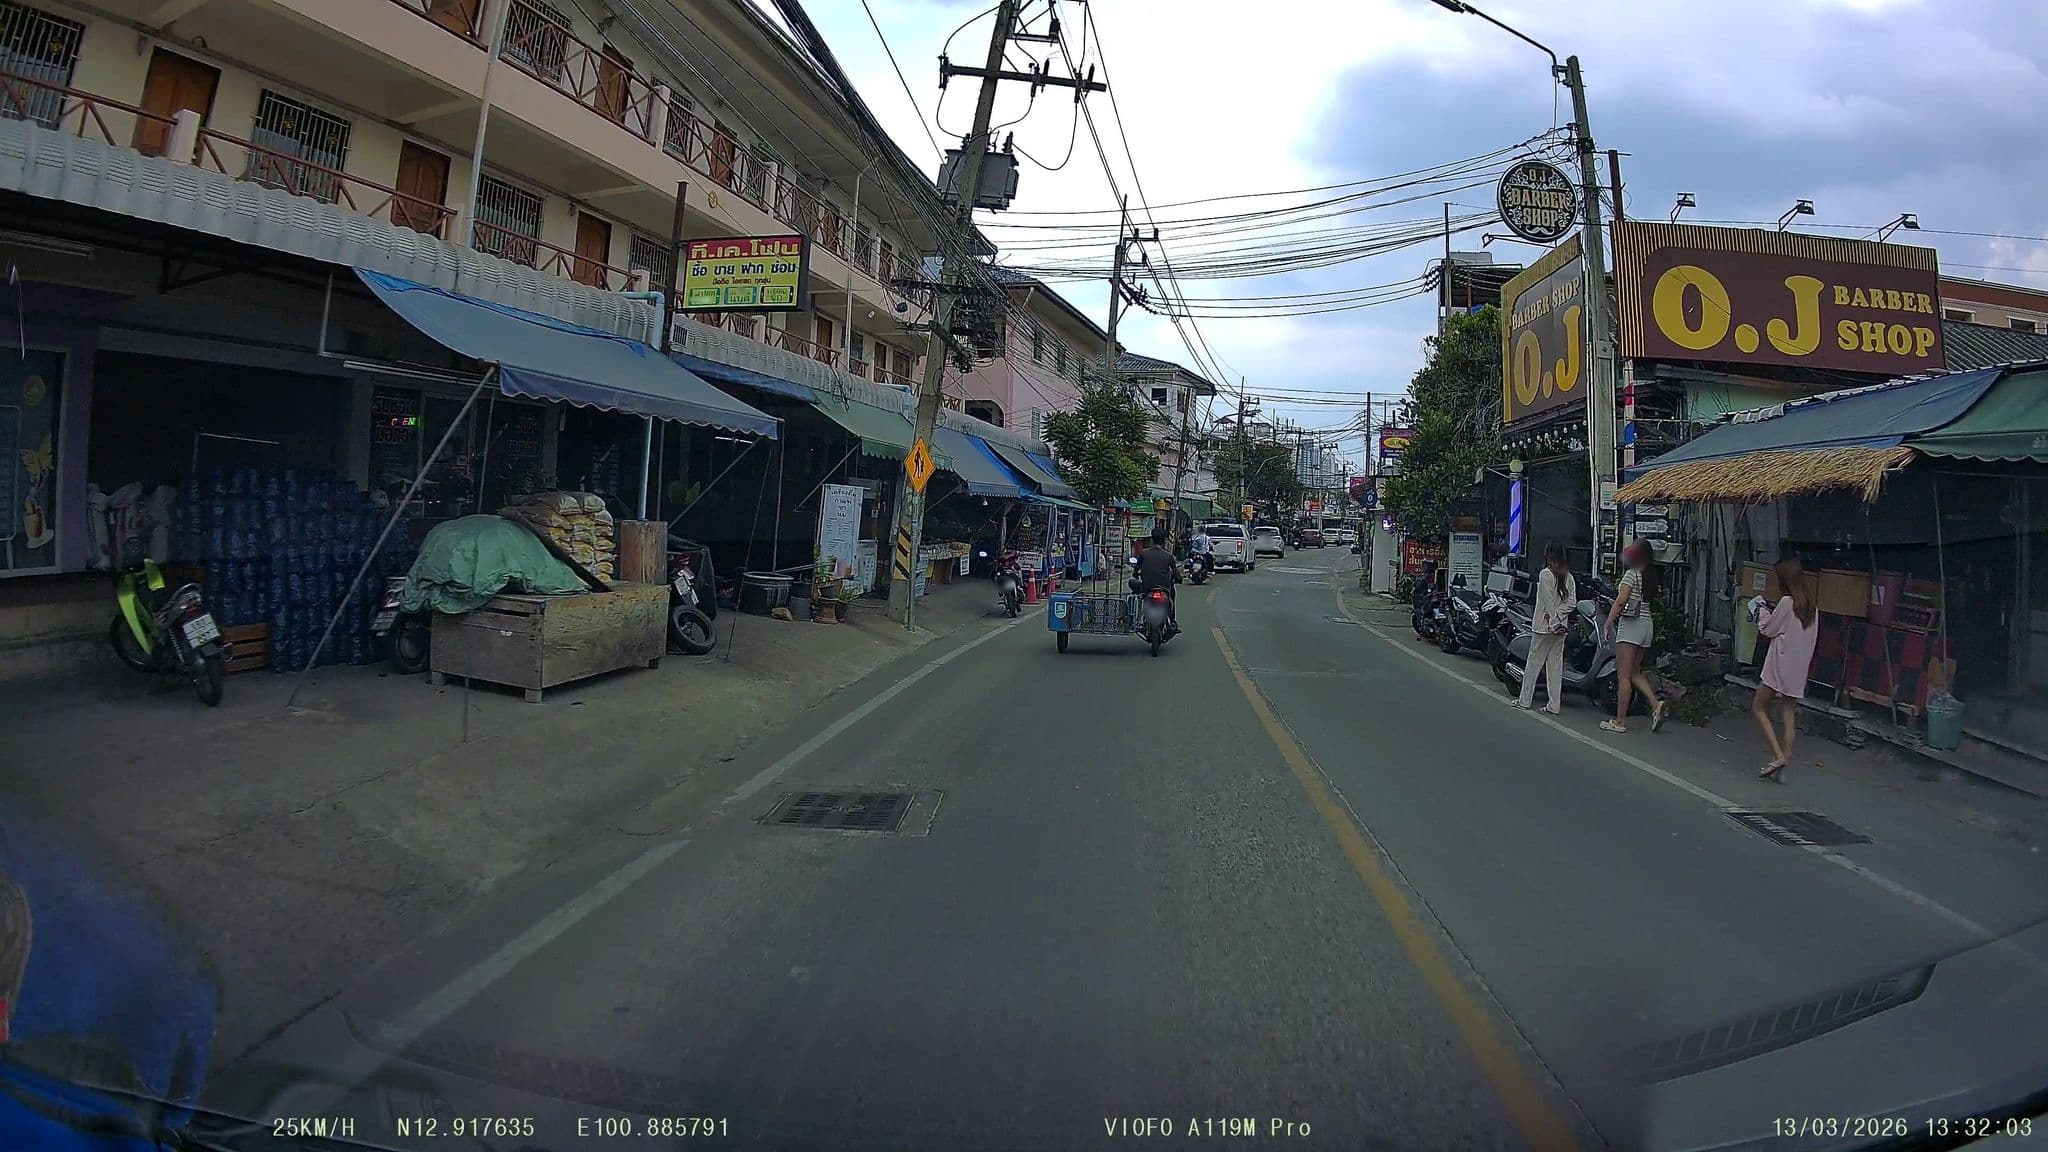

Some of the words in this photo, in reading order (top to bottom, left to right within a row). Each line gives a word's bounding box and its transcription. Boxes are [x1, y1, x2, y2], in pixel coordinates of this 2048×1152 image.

[1511, 188, 1569, 210] BARBER
[1523, 207, 1558, 227] SHOP
[714, 265, 735, 275] ขาย
[741, 262, 764, 274] ฝาก
[1512, 295, 1550, 331] BARBER
[1551, 276, 1581, 309] SHOP
[1653, 265, 1824, 355] O.J
[1833, 285, 1934, 314] BARBER
[1837, 320, 1935, 357] SHOP
[1513, 305, 1581, 406] O.J
